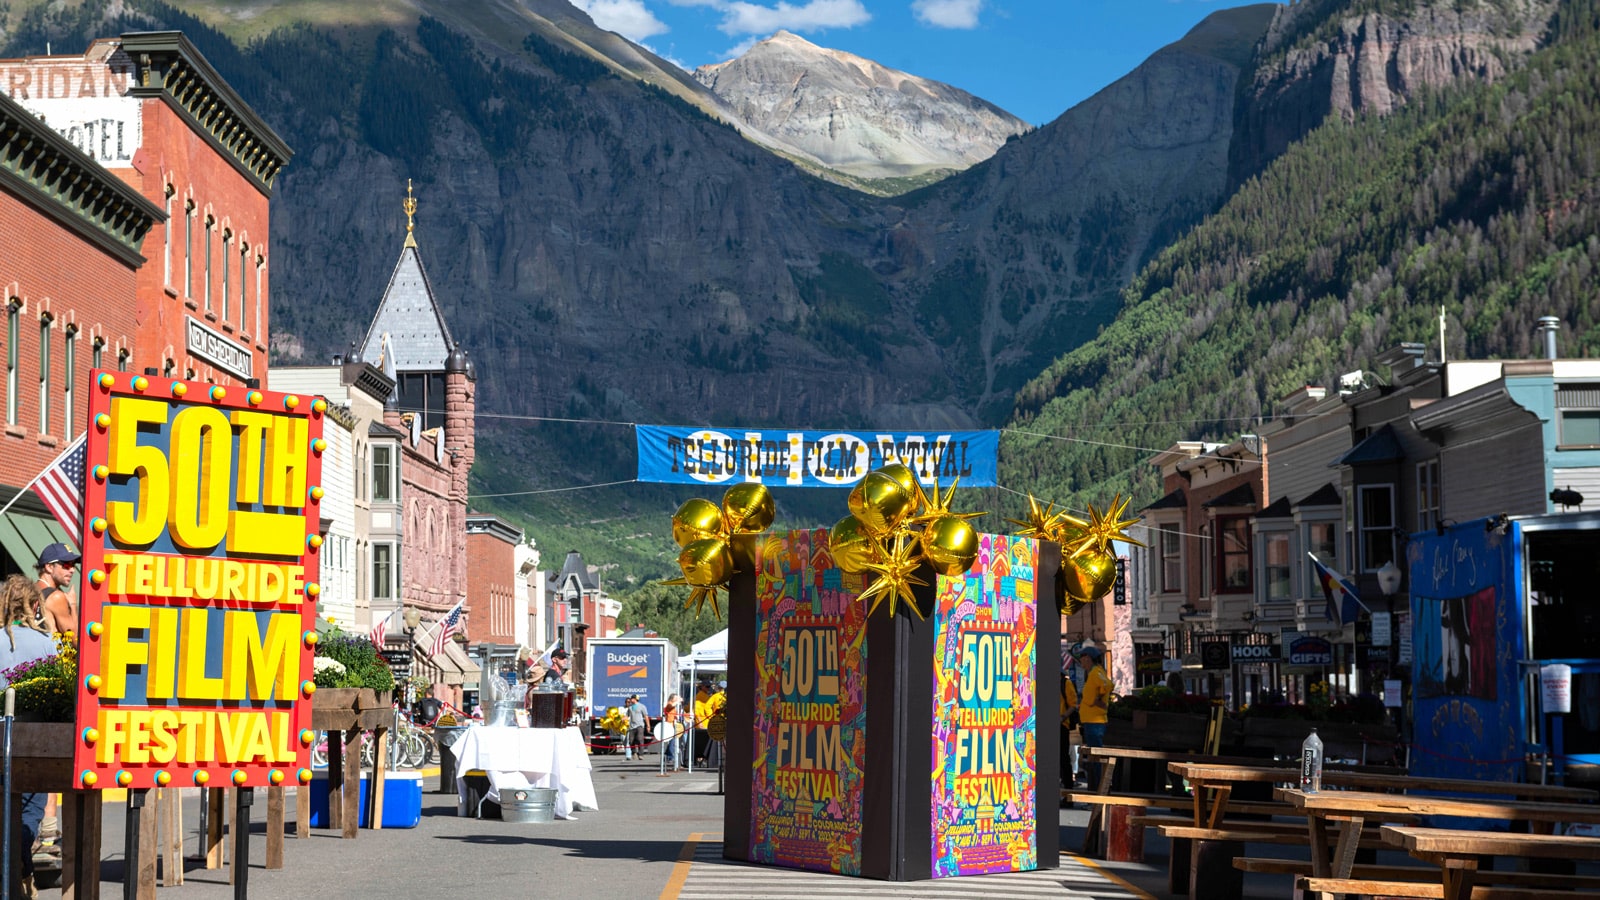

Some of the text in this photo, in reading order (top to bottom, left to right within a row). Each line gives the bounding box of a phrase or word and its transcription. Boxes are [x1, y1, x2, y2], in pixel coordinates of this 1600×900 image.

[0, 66, 128, 99] RIDAN
[190, 322, 251, 377] NEW SHERIDAN
[106, 397, 309, 549] 50TH
[668, 436, 972, 477] TELLURIDE FILM FESTIVAL
[104, 554, 304, 604] TELLURIDE
[98, 605, 302, 701] FILM
[607, 652, 648, 666] Budget
[781, 629, 839, 696] 50TH
[960, 634, 1012, 702] 50TH
[1232, 646, 1272, 657] HOOK
[1291, 653, 1330, 663] GIFTS
[780, 702, 840, 722] TELLURIDE
[959, 708, 1014, 726] TELLURIDE
[96, 709, 297, 763] FESTIVAL
[777, 722, 841, 771] FILM
[955, 728, 1016, 775] FILM
[775, 770, 842, 802] FESTIVAL
[953, 776, 1018, 806] FESTIVAL
